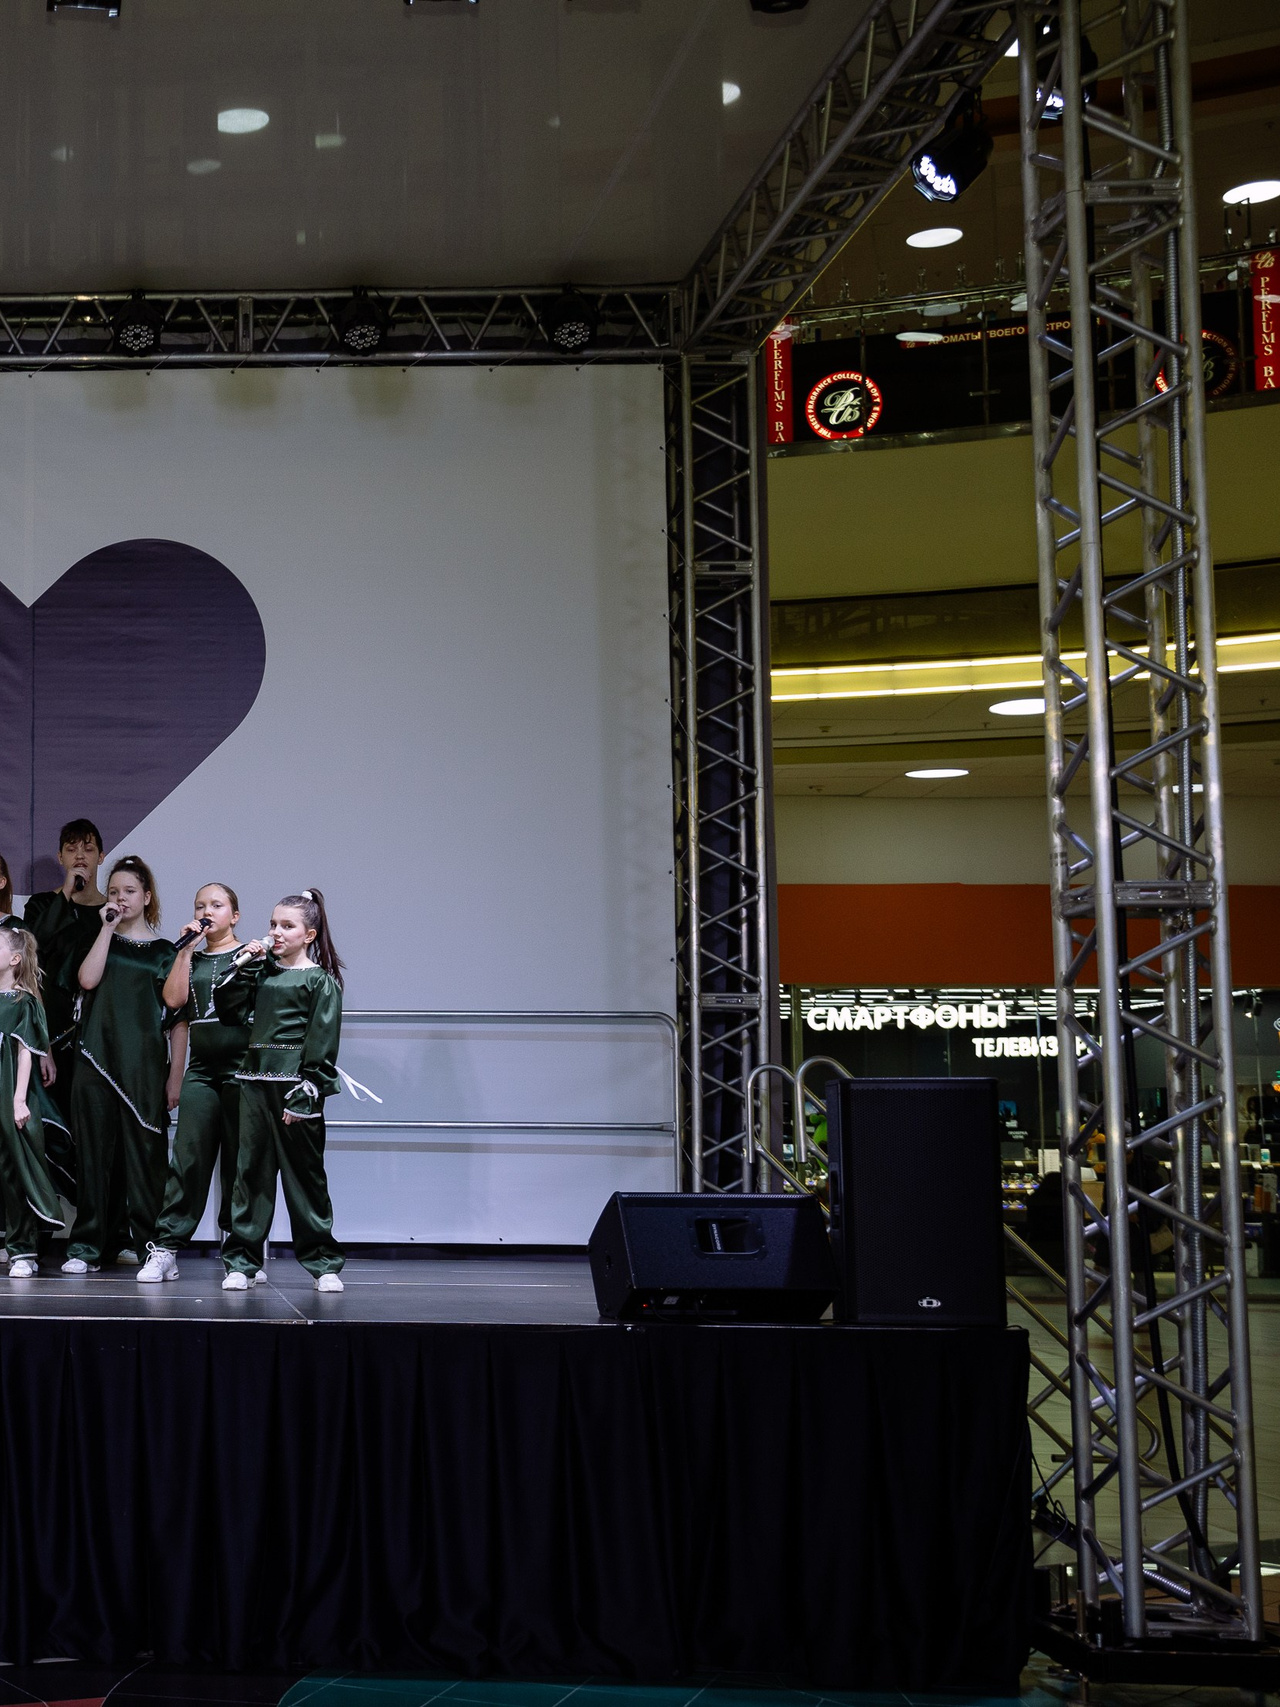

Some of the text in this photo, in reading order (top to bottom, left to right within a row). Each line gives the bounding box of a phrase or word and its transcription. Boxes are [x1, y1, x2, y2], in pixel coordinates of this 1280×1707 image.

[987, 327, 1025, 338] ВОЕГО
[773, 340, 786, 412] PERFUMS
[806, 1004, 1007, 1031] СМАРТФОНЫ
[971, 1035, 1102, 1058] ТЕЛЕВИЗР
